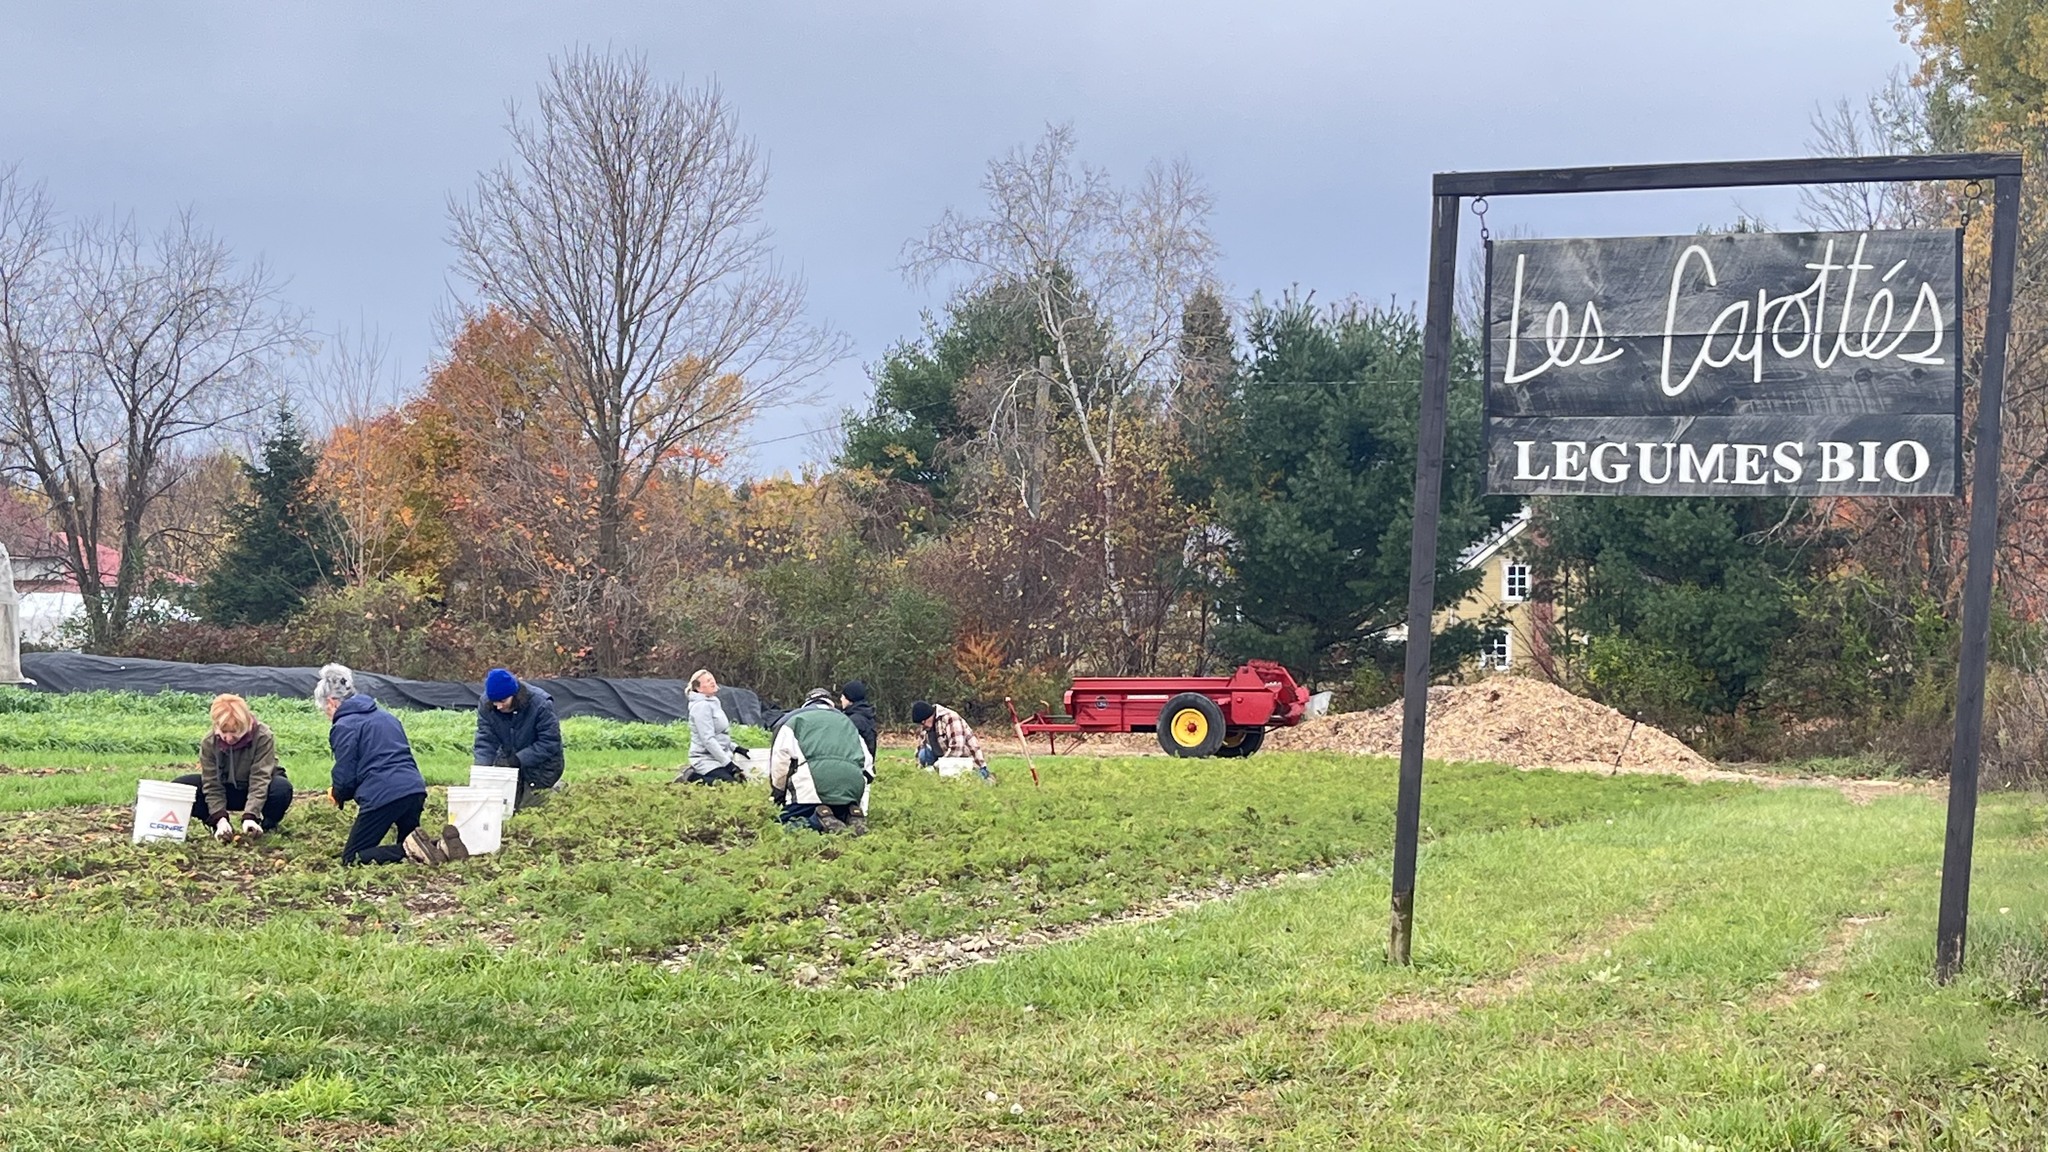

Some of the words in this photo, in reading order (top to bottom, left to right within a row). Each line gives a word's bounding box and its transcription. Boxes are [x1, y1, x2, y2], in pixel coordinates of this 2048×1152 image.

[1504, 252, 1624, 385] Les
[1513, 440, 1804, 484] LEGUMES
[1816, 440, 1930, 484] BIO
